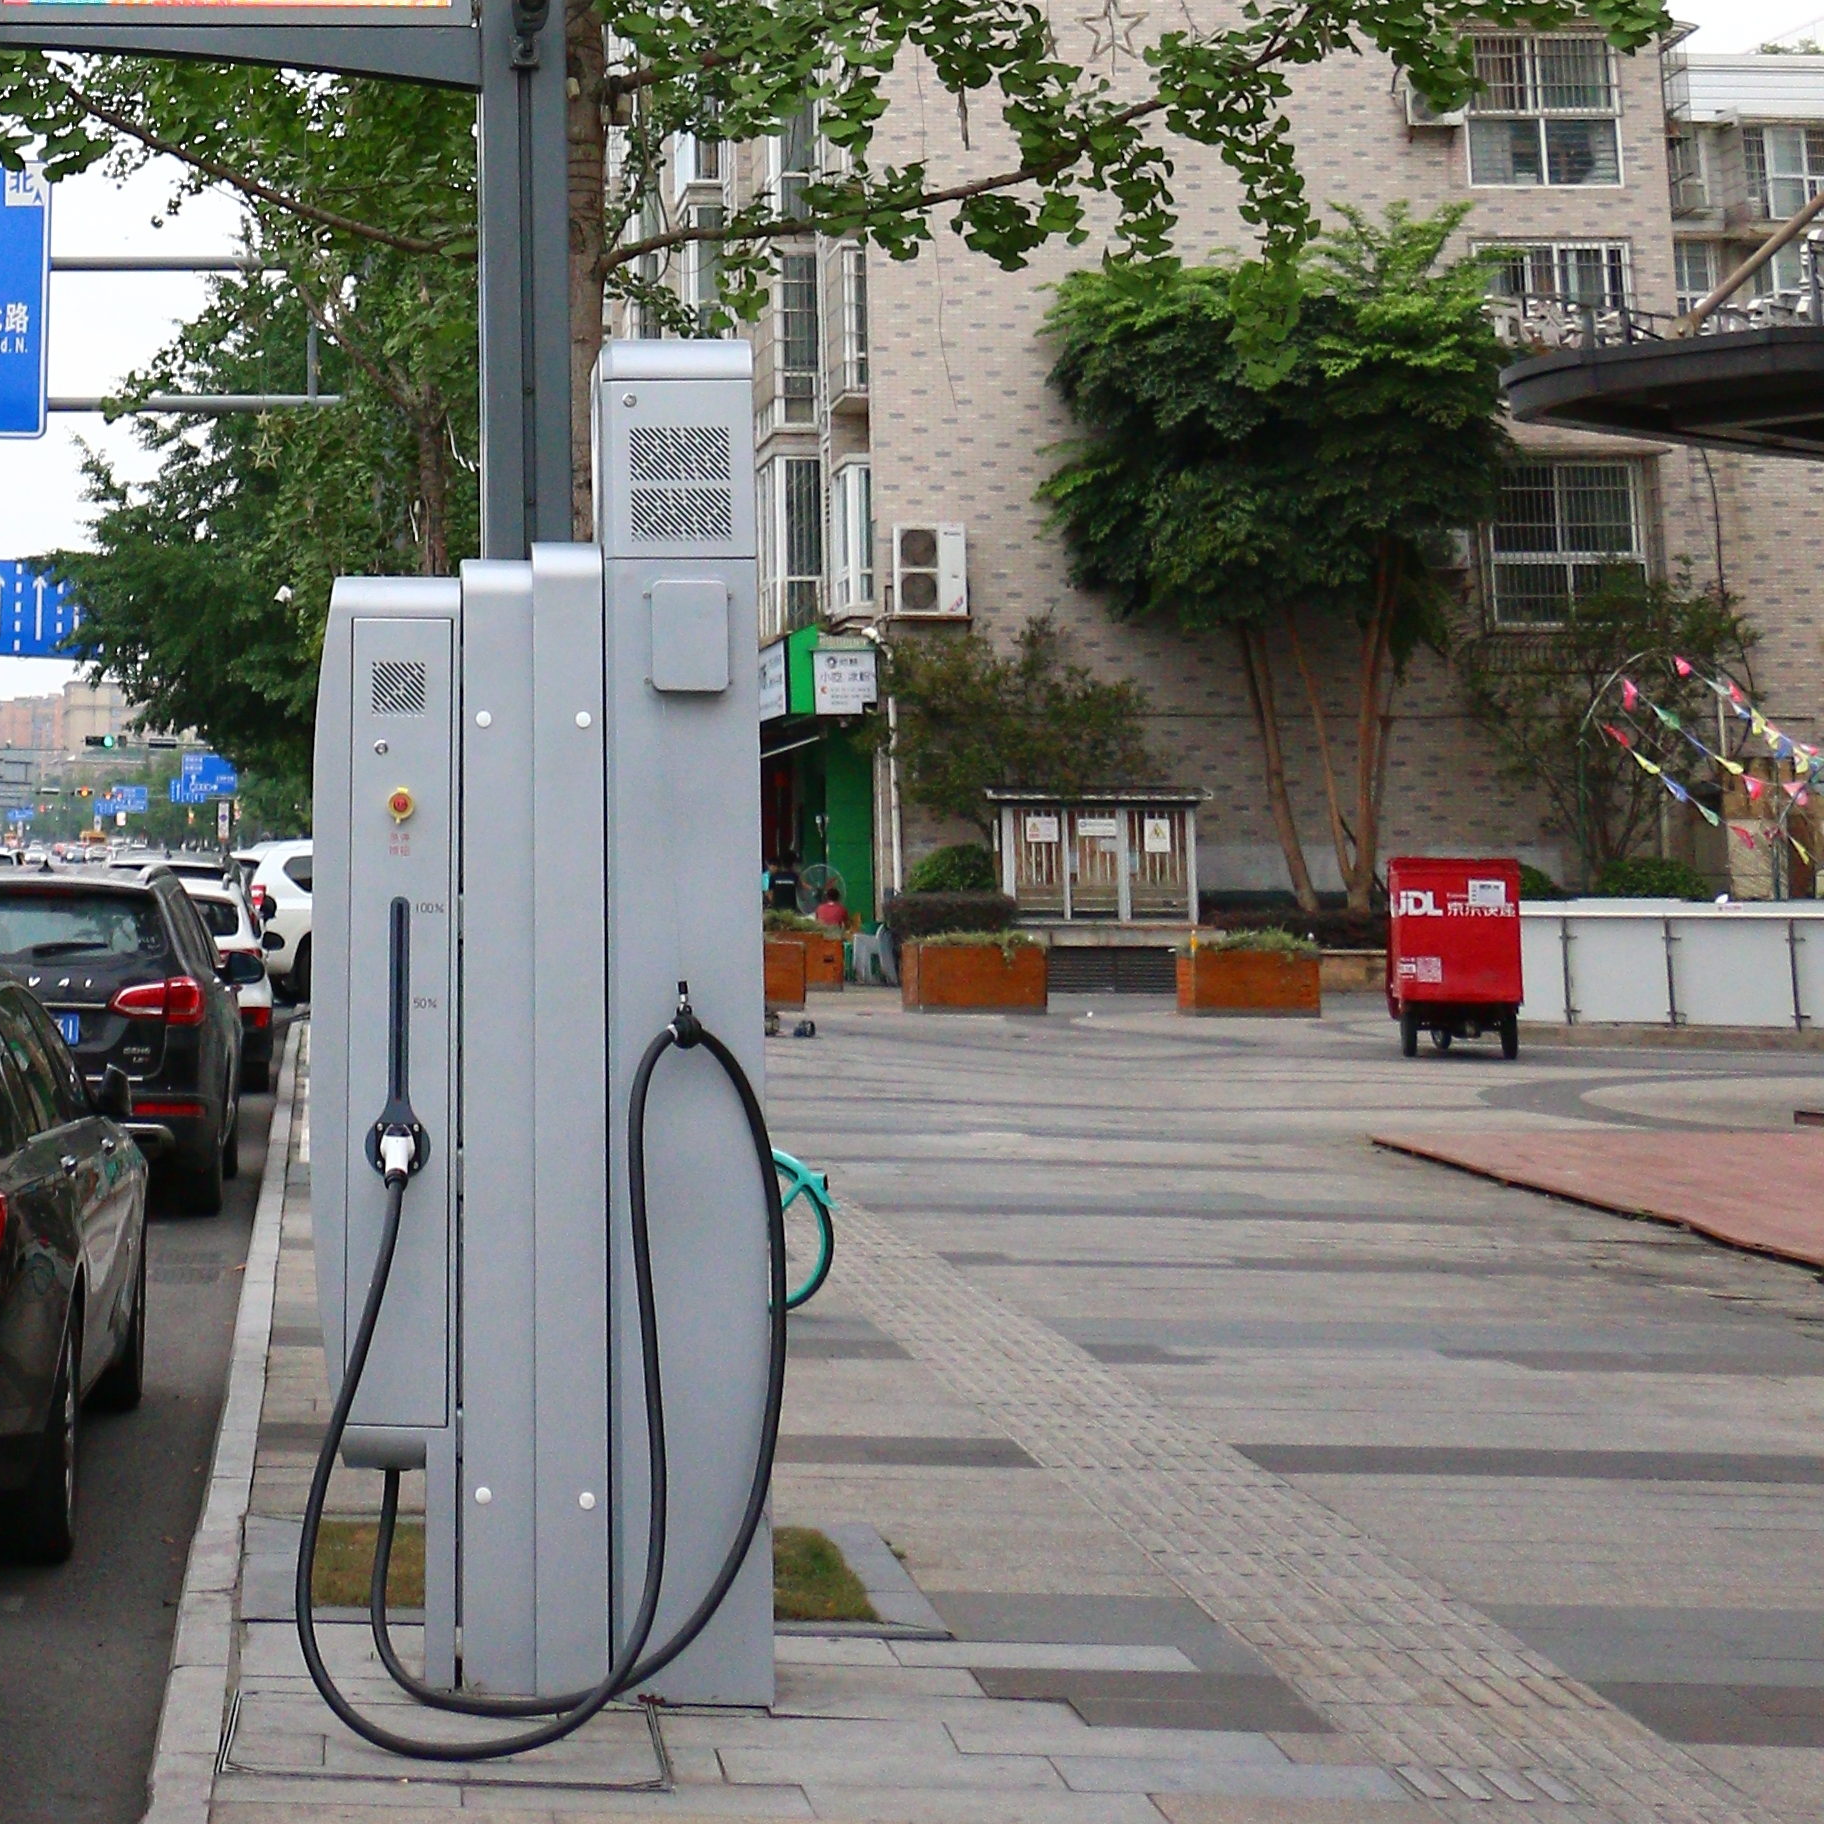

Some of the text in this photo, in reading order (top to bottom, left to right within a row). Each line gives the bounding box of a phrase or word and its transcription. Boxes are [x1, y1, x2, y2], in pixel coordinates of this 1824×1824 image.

[9, 170, 34, 194] 北
[415, 902, 444, 914] 100%
[1397, 890, 1443, 917] JDL
[413, 998, 437, 1009] 50%
